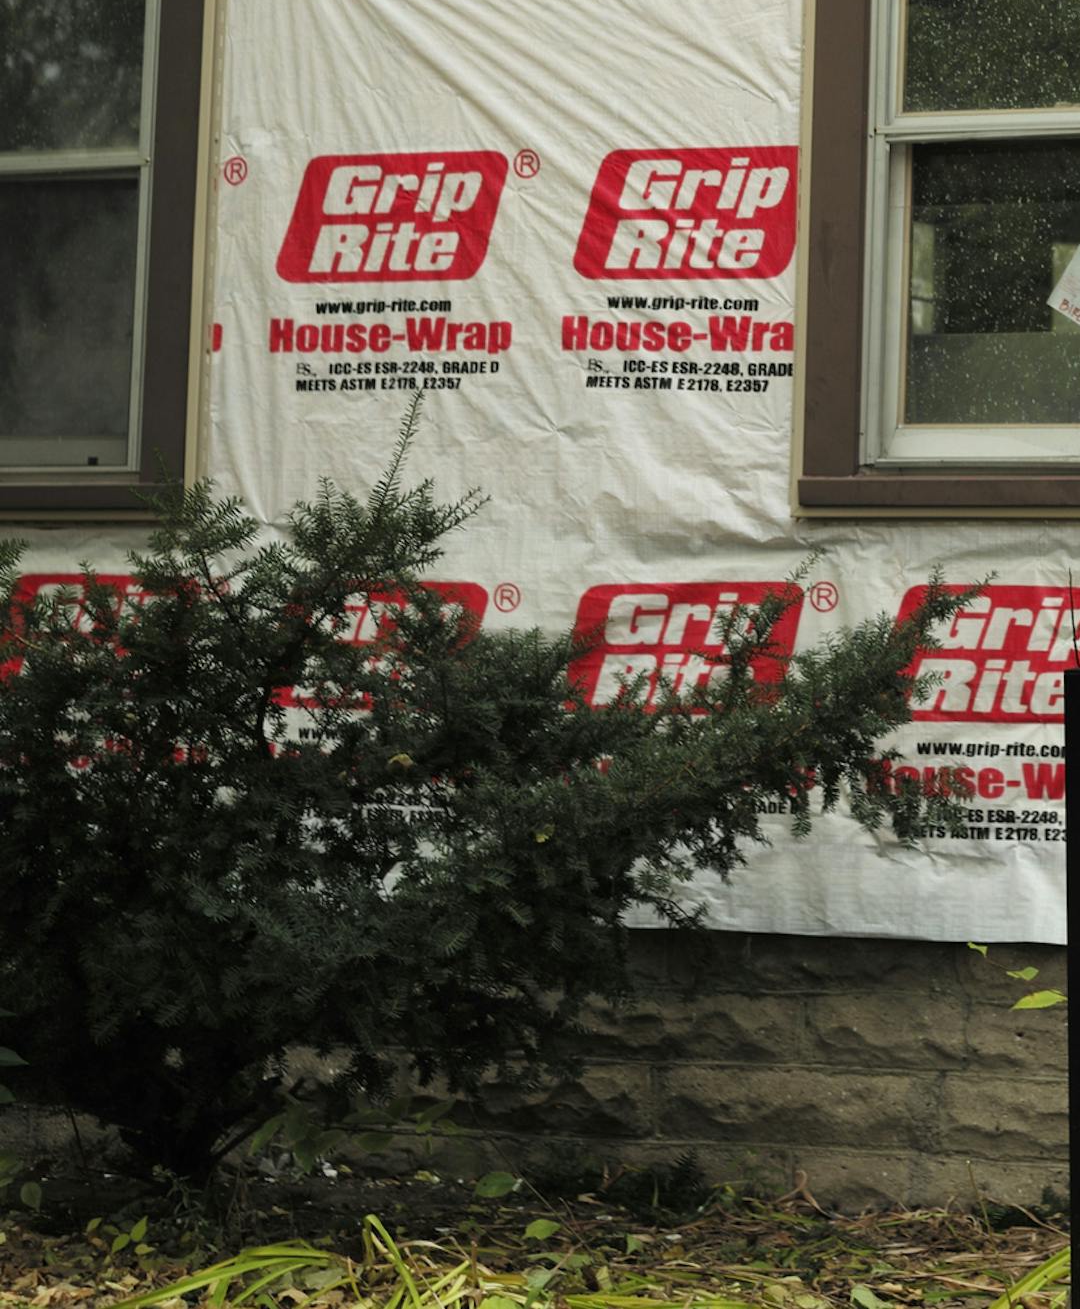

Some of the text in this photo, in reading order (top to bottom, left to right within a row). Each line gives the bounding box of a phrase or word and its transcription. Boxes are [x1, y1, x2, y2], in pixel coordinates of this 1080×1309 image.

[322, 161, 484, 223] Grip
[618, 157, 793, 219] Grip
[308, 221, 460, 274] Rite
[603, 218, 768, 270] Rite
[315, 298, 452, 315] www.grip-rite.com
[609, 295, 758, 312] www.grip-rite.com
[269, 316, 513, 355] House-Wrap
[562, 314, 794, 352] House-Wra
[328, 361, 372, 375] ICC-ES
[442, 360, 487, 375] GRADE
[490, 361, 500, 374] D
[621, 360, 669, 374] ICC-ES
[295, 376, 462, 392] MEETS ASTM E2357
[586, 375, 770, 394] MEETS ASTM E2357
